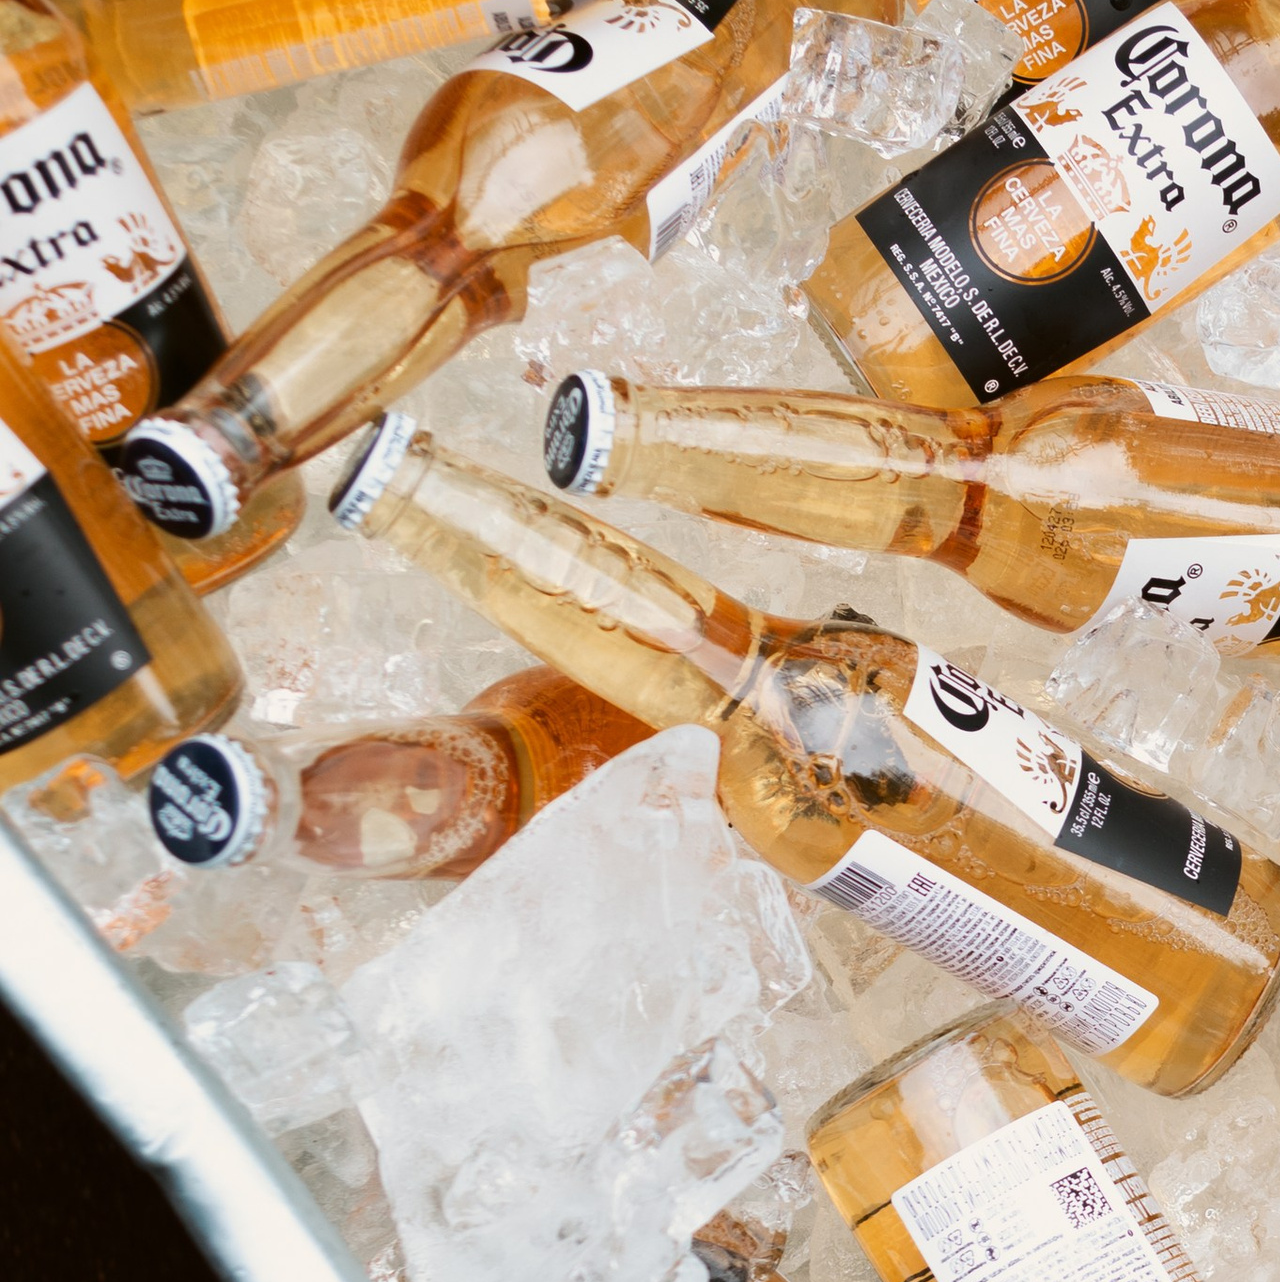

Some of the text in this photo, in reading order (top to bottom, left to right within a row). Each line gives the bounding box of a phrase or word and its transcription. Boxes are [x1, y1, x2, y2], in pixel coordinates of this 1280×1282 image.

[1023, 41, 1066, 70] FINA
[1115, 25, 1261, 215] Corona
[0, 133, 106, 213] ona
[1102, 90, 1185, 212] Extra
[1001, 207, 1036, 249] MAS
[1006, 177, 1066, 261] CERVEZA
[1038, 191, 1062, 220] LA
[984, 217, 1018, 262] FINA
[889, 243, 952, 327] REG. S.S.A. 7417
[893, 187, 1029, 378] CERVECERIA MODELO, S. DE R.L. DE C.V.
[918, 257, 961, 309] MEXICO
[59, 353, 94, 376] LA
[71, 384, 120, 414] MAS
[80, 403, 132, 434] FINA
[1183, 819, 1205, 880] CERVECERIA
